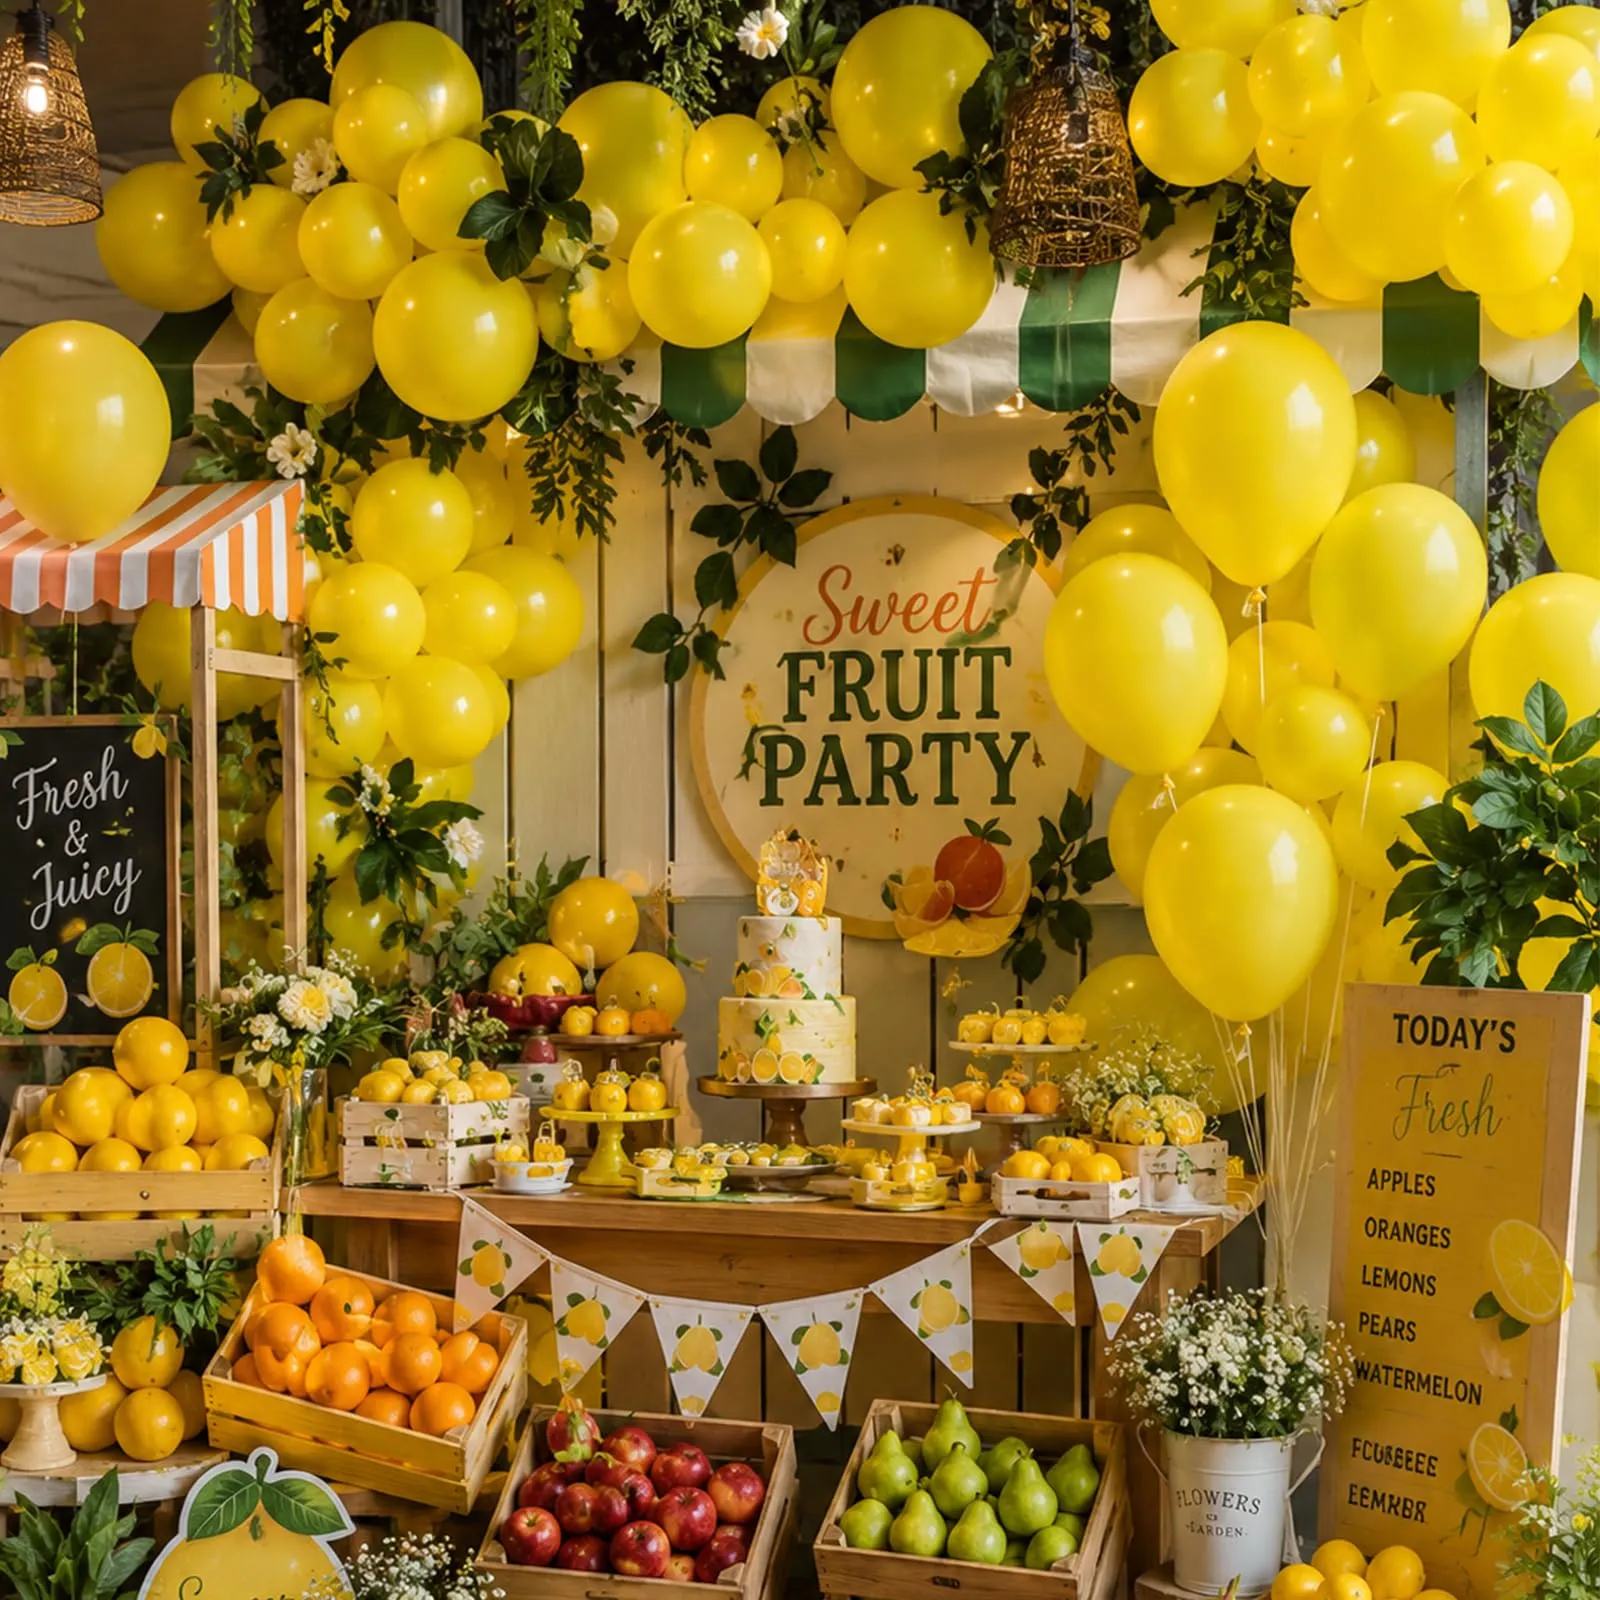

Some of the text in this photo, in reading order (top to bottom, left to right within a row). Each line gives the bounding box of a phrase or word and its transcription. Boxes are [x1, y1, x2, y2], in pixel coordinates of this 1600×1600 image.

[803, 564, 998, 645] Sweet
[776, 646, 1012, 723] FRUIT
[12, 745, 129, 831] Fresh
[758, 731, 1031, 807] PARTY
[64, 818, 89, 857] &
[30, 858, 142, 931] Juicy
[1393, 1012, 1517, 1054] TODAY'S
[1392, 1064, 1504, 1142] Fresh
[1366, 1167, 1436, 1198] APPLES
[1364, 1216, 1451, 1249] ORANGES
[1361, 1264, 1437, 1297] LEMONS
[1358, 1311, 1417, 1343] PEARS
[1354, 1359, 1482, 1406] WATERMELON
